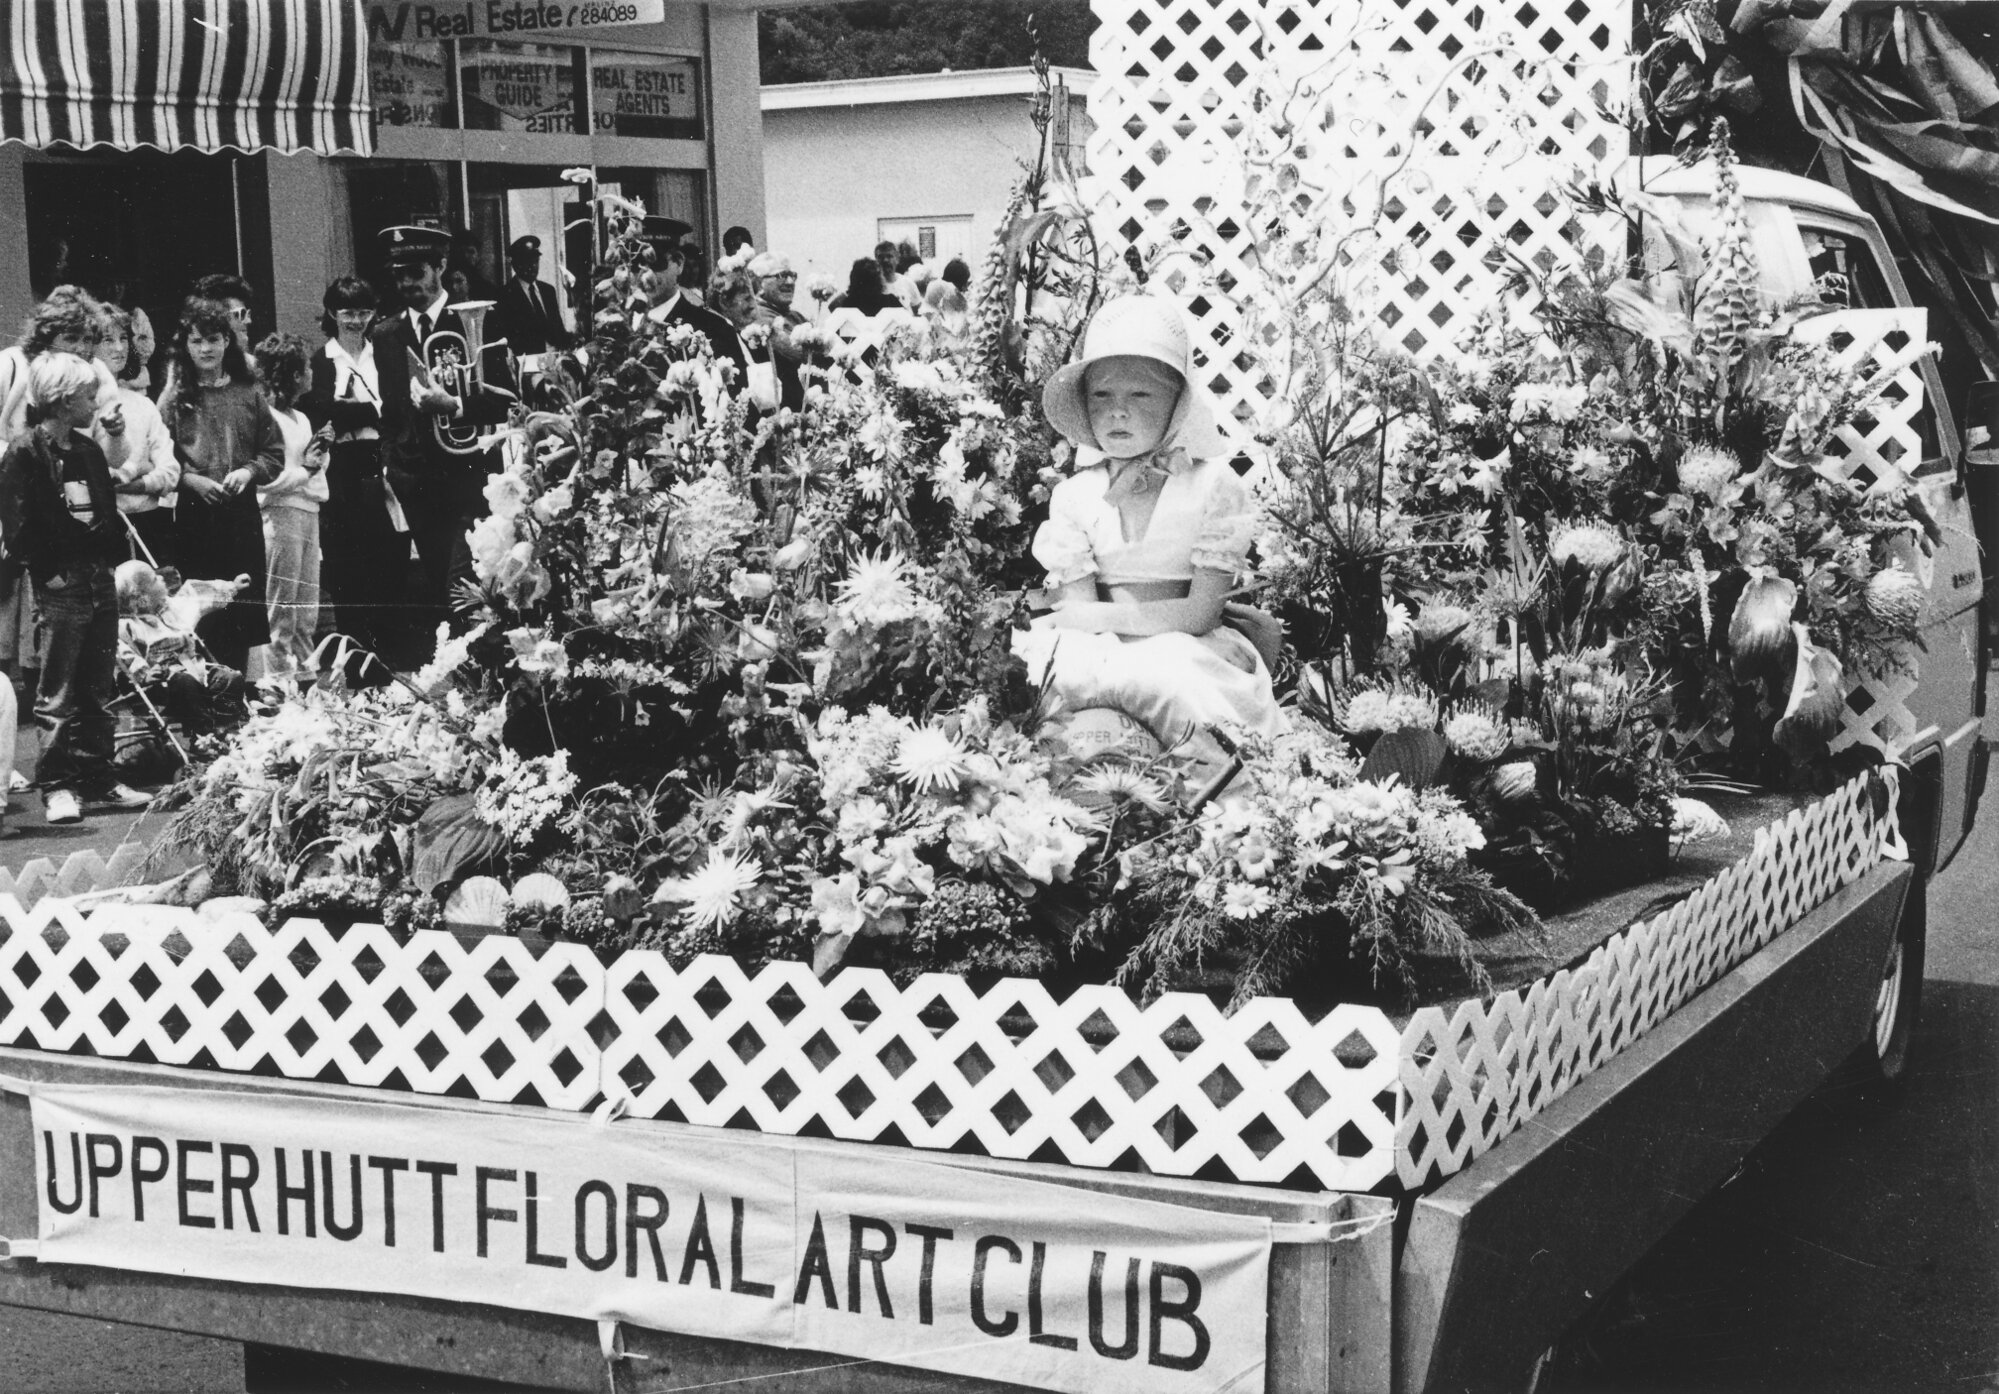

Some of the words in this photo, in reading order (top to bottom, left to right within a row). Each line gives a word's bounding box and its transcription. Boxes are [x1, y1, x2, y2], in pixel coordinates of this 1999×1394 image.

[415, 1, 475, 38] Real
[487, 0, 562, 33] Estate
[581, 4, 637, 26] 284089
[480, 61, 553, 84] PROPERTY
[593, 67, 630, 90] REAL
[635, 70, 685, 94] ESTATE
[495, 82, 543, 107] GUIDE
[616, 91, 671, 115] AGENTS
[43, 1130, 261, 1233] UPPER
[274, 1146, 457, 1253] HUTT
[475, 1165, 776, 1299] FLORAL
[793, 1209, 954, 1326] ART
[970, 1234, 1211, 1372] CLUB
